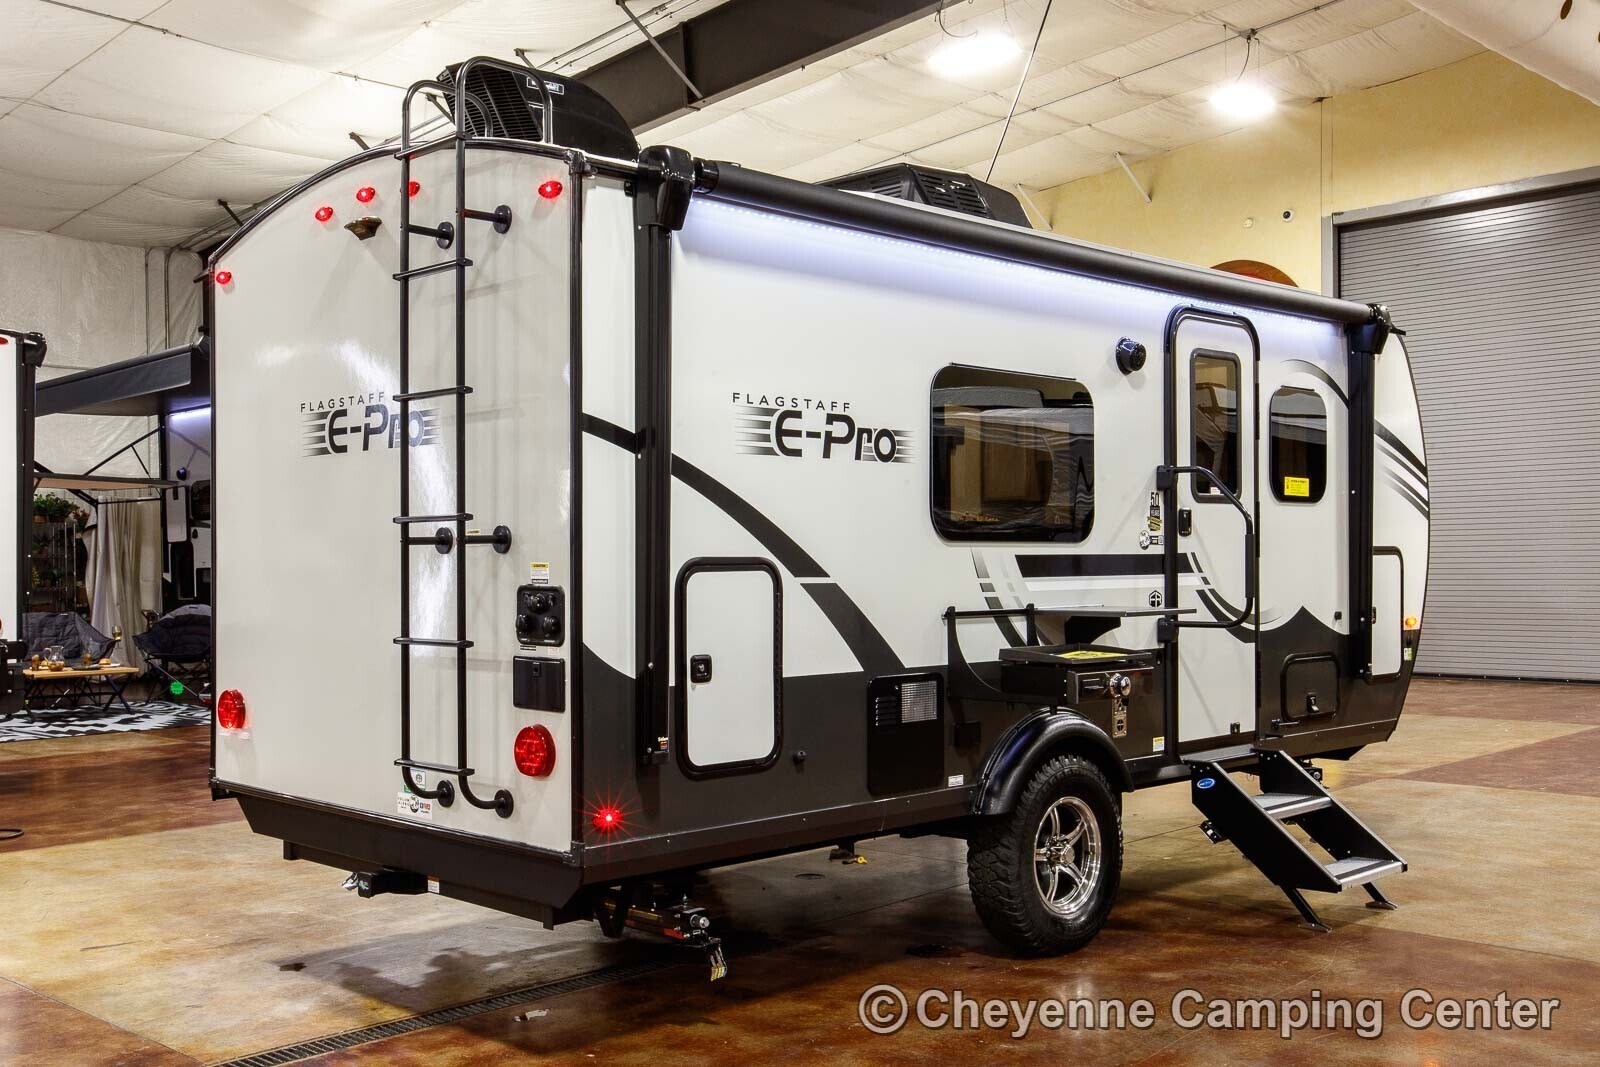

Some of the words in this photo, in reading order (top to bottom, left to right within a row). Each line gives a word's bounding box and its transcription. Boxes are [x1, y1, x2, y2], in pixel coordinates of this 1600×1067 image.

[300, 391, 385, 413] FLAGSTAFF
[732, 392, 851, 413] FLAGSTAFF
[774, 409, 897, 463] E-Pro
